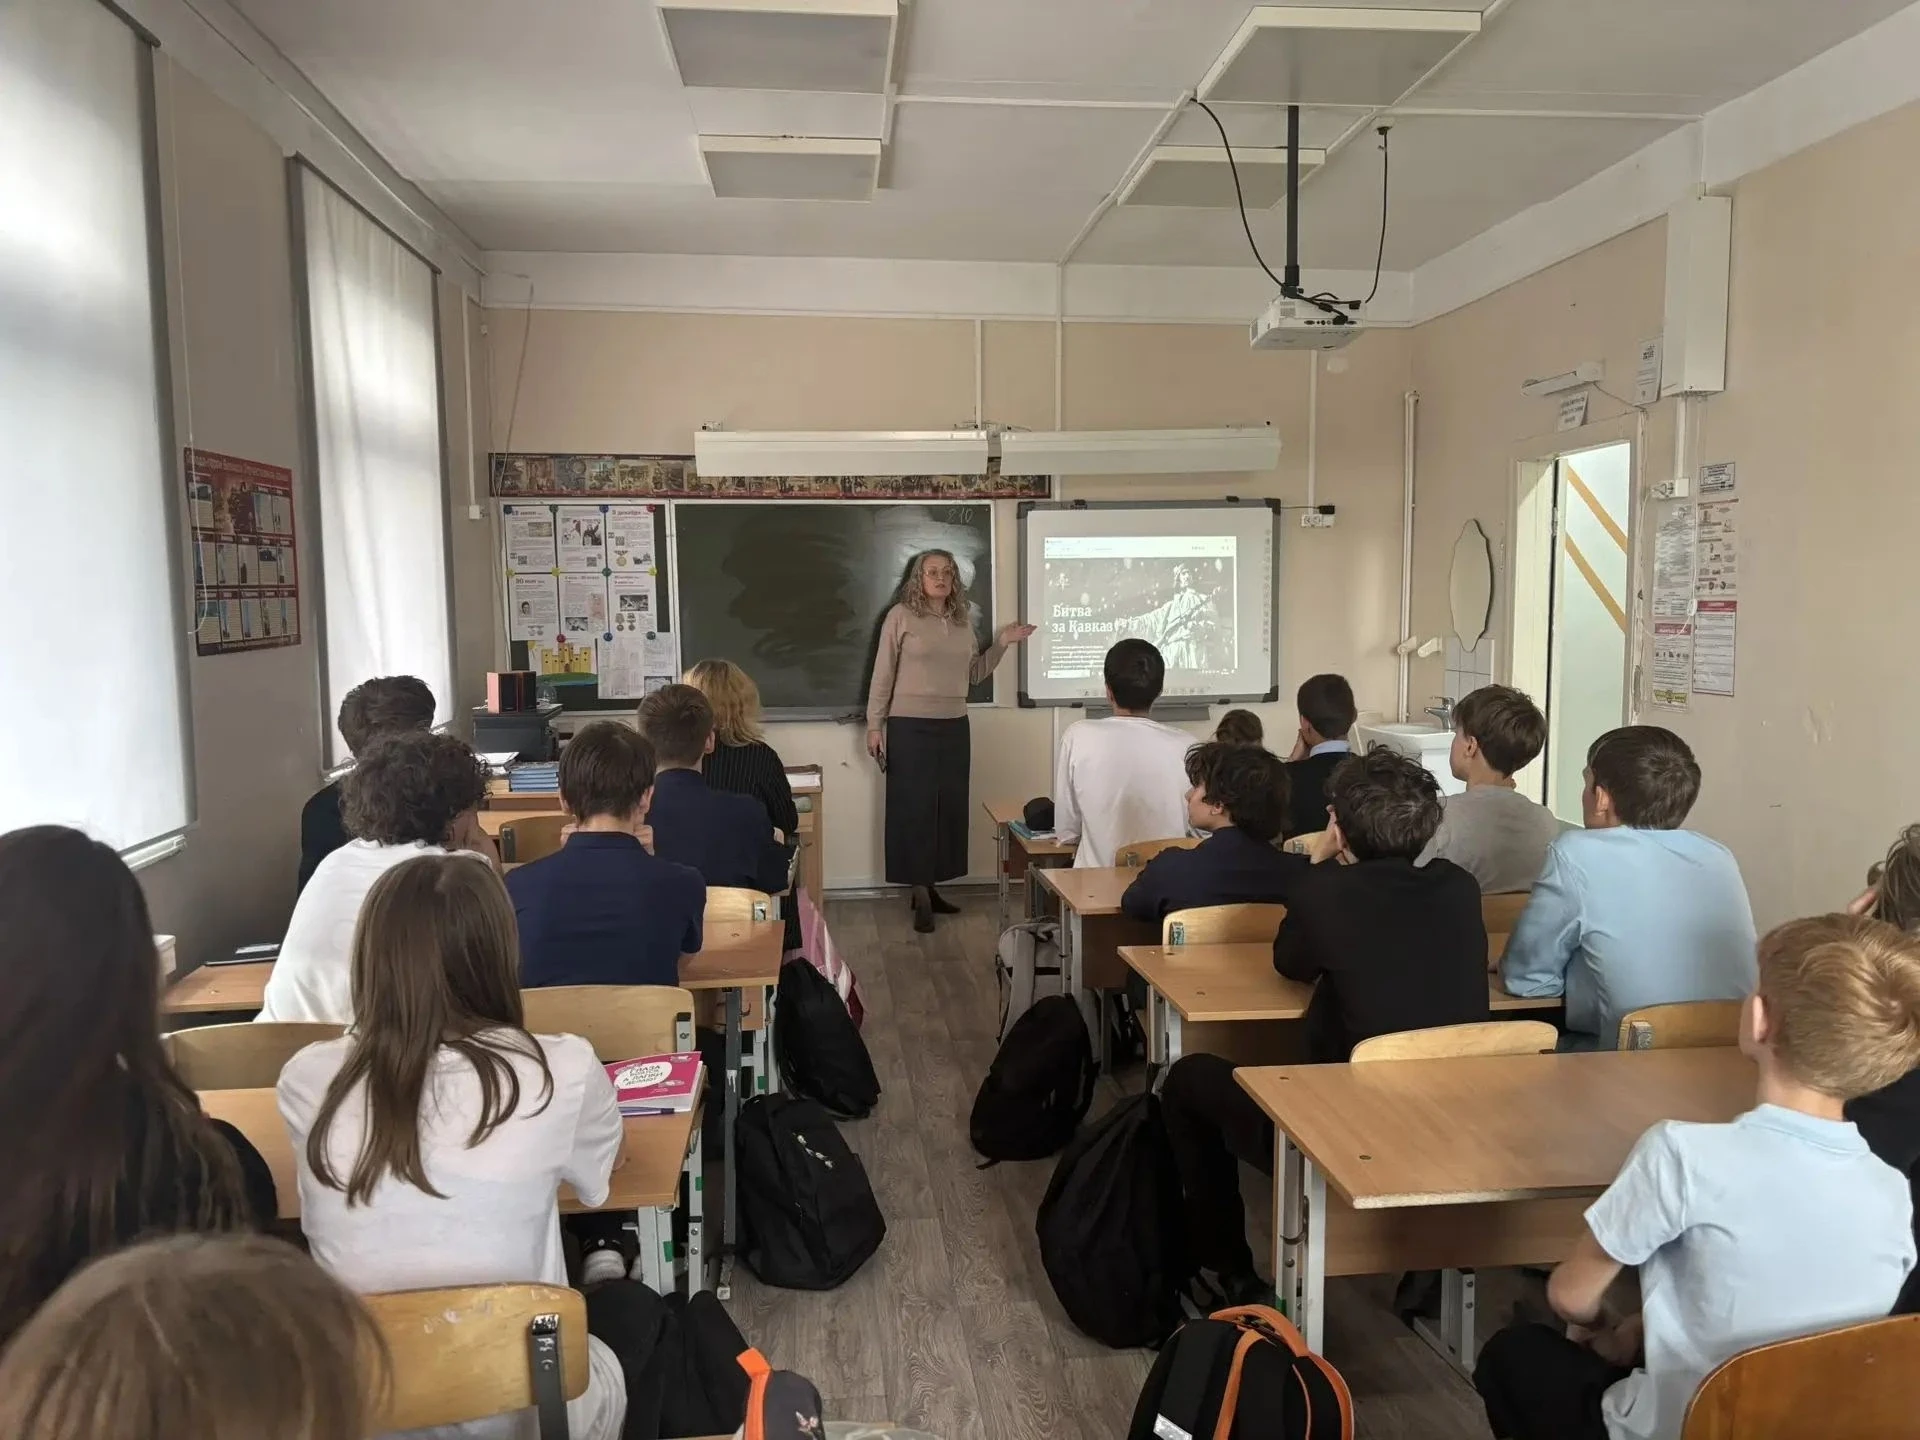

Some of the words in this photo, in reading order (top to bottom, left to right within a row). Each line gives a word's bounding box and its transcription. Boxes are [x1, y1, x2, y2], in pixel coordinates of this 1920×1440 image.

[1053, 604, 1092, 617] Битва
[1051, 622, 1066, 633] за
[1068, 620, 1113, 633] Кавказ
